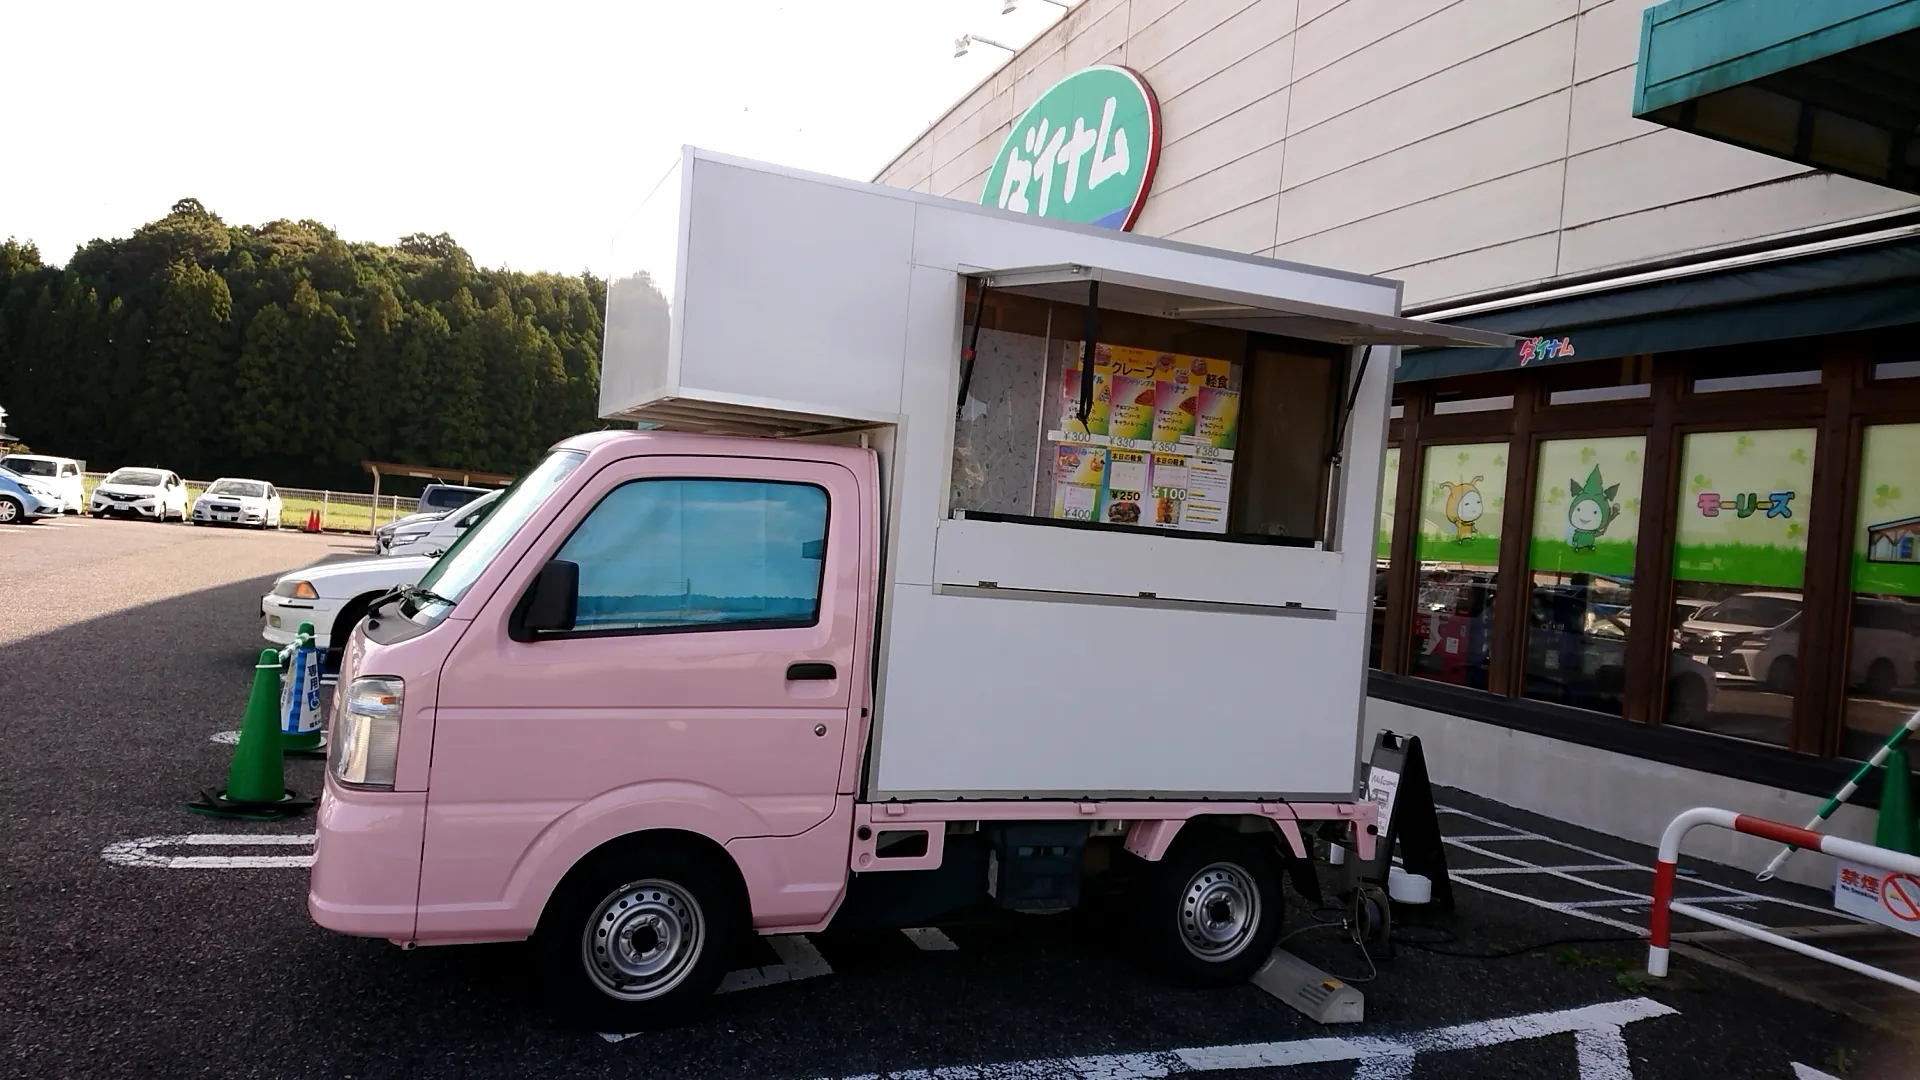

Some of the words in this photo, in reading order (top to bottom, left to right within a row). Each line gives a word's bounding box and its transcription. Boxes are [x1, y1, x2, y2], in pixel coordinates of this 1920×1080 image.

[999, 96, 1130, 217] ダイナム
[1520, 336, 1575, 366] ダイナム
[1205, 374, 1229, 389] 軽食
[1064, 431, 1091, 442] ¥300
[1109, 436, 1135, 448] ¥330
[1151, 441, 1177, 453] ¥350
[1195, 445, 1220, 457] ¥380
[1112, 453, 1143, 462] 本日の軽食
[1155, 456, 1185, 466] 本日の軽食
[1112, 491, 1141, 501] ¥250
[1152, 486, 1186, 500] ¥100
[1697, 491, 1795, 518] モーリーズ
[1064, 508, 1091, 519] ¥400
[1841, 868, 1880, 895] 禁煙
